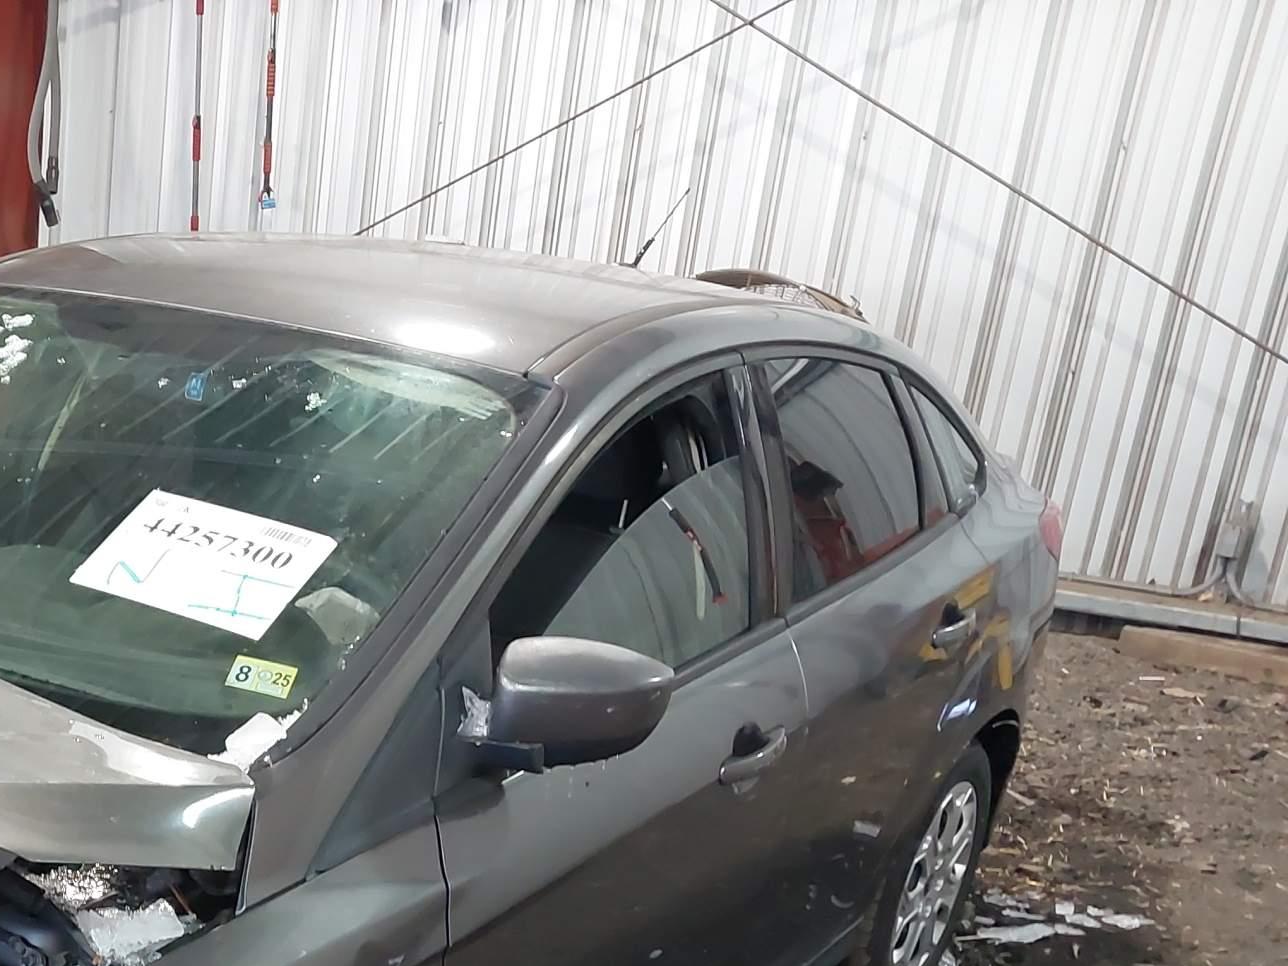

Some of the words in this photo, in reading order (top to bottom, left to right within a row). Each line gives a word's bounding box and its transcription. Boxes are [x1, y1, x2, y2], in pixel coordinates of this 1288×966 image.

[143, 517, 293, 569] 44257300
[235, 665, 252, 682] 8
[272, 672, 292, 688] 25
